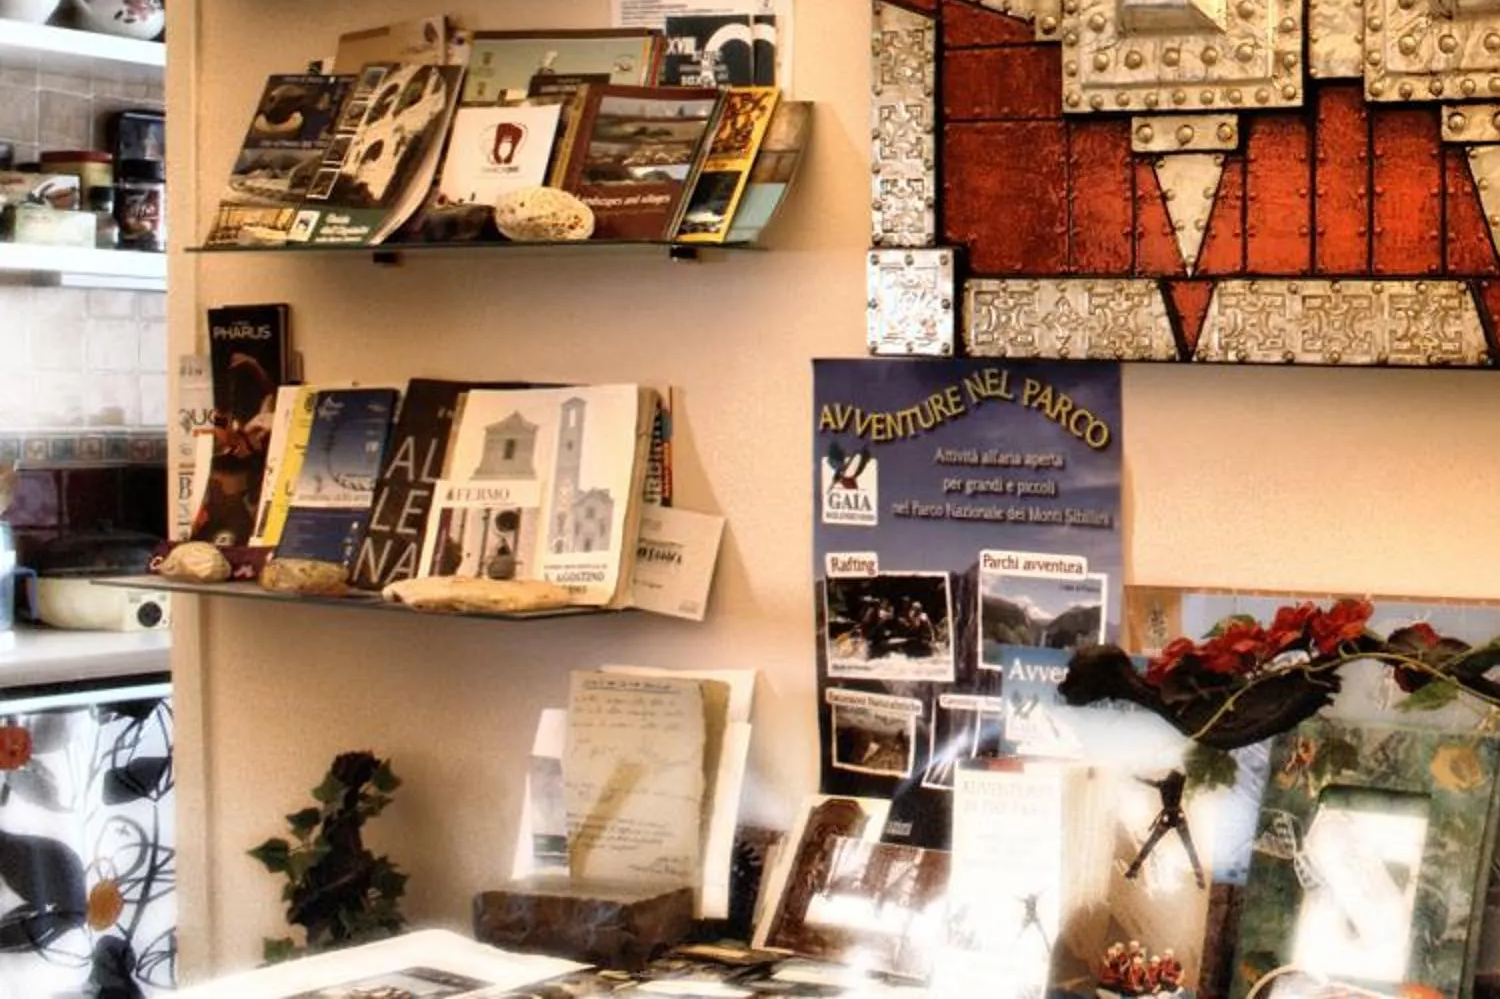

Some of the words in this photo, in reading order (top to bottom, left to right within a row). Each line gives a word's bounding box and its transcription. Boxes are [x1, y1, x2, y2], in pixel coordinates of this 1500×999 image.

[213, 324, 273, 341] PHARUS
[819, 385, 966, 441] AVVENTURE
[963, 367, 1015, 403] NEL
[1023, 376, 1110, 449] PARCO
[943, 479, 964, 493] per
[828, 492, 872, 511] GAIA
[831, 556, 876, 575] Rafting
[983, 553, 1019, 571] Parchi
[1022, 560, 1083, 575] avventura
